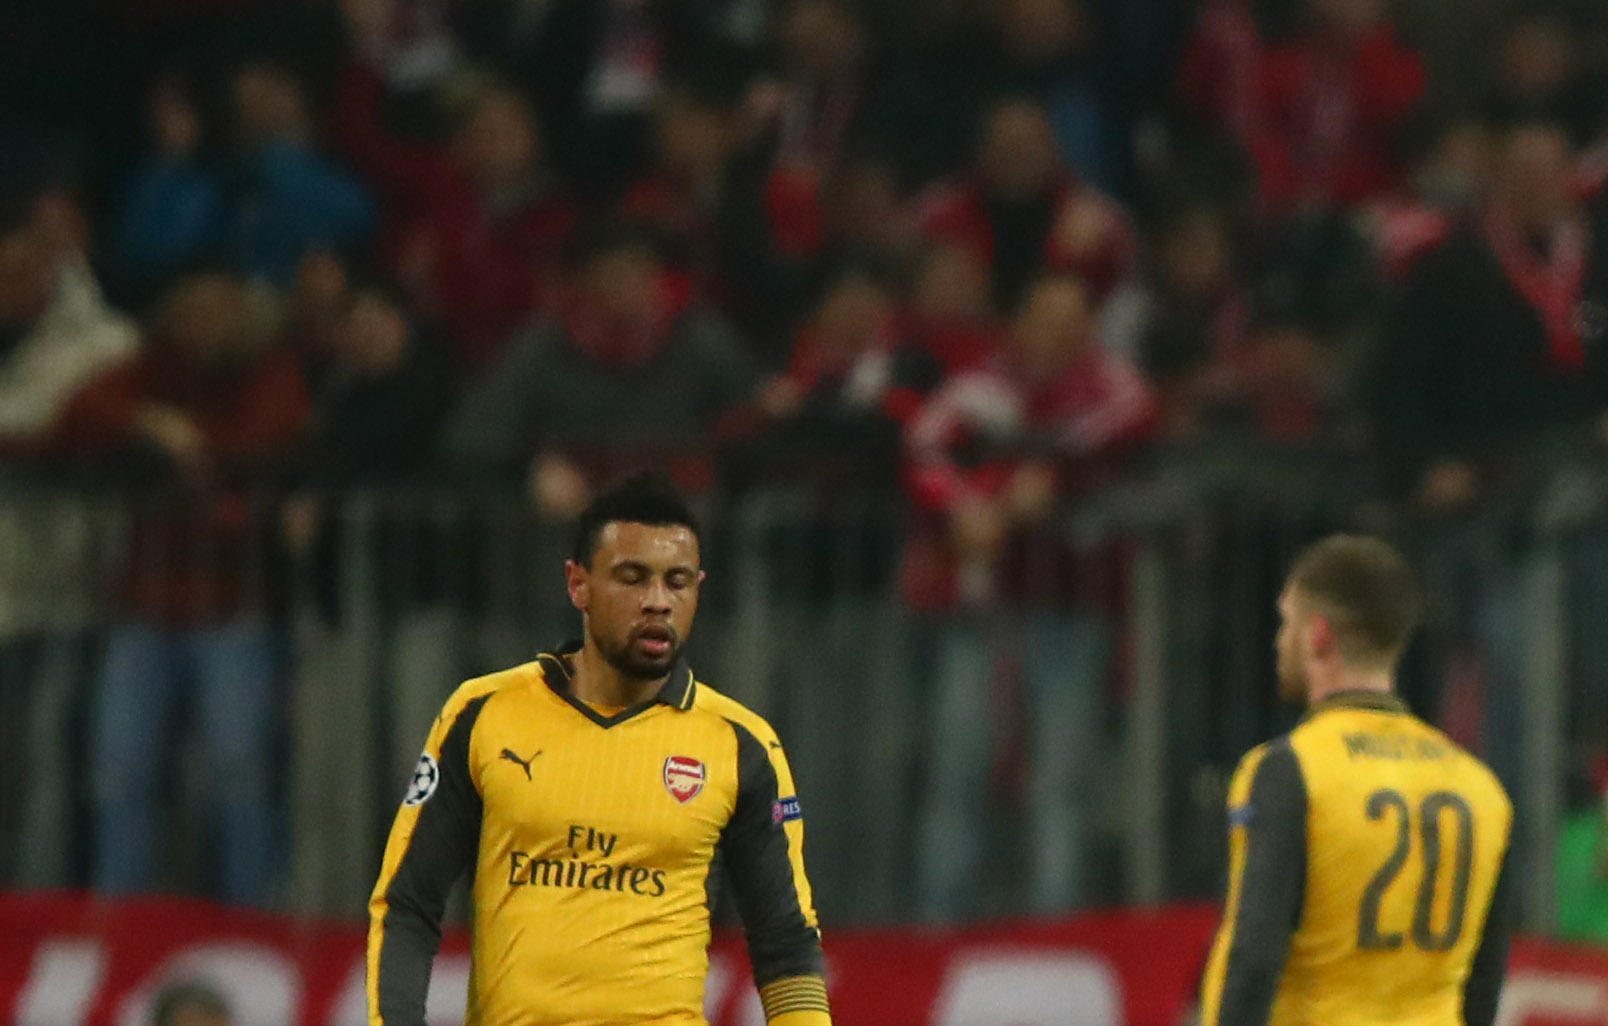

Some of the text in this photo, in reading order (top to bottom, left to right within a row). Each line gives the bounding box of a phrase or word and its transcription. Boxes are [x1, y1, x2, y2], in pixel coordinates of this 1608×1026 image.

[783, 802, 801, 815] RES
[568, 823, 617, 858] Fly
[508, 851, 667, 898] Emirates
[1359, 790, 1473, 951] 20
